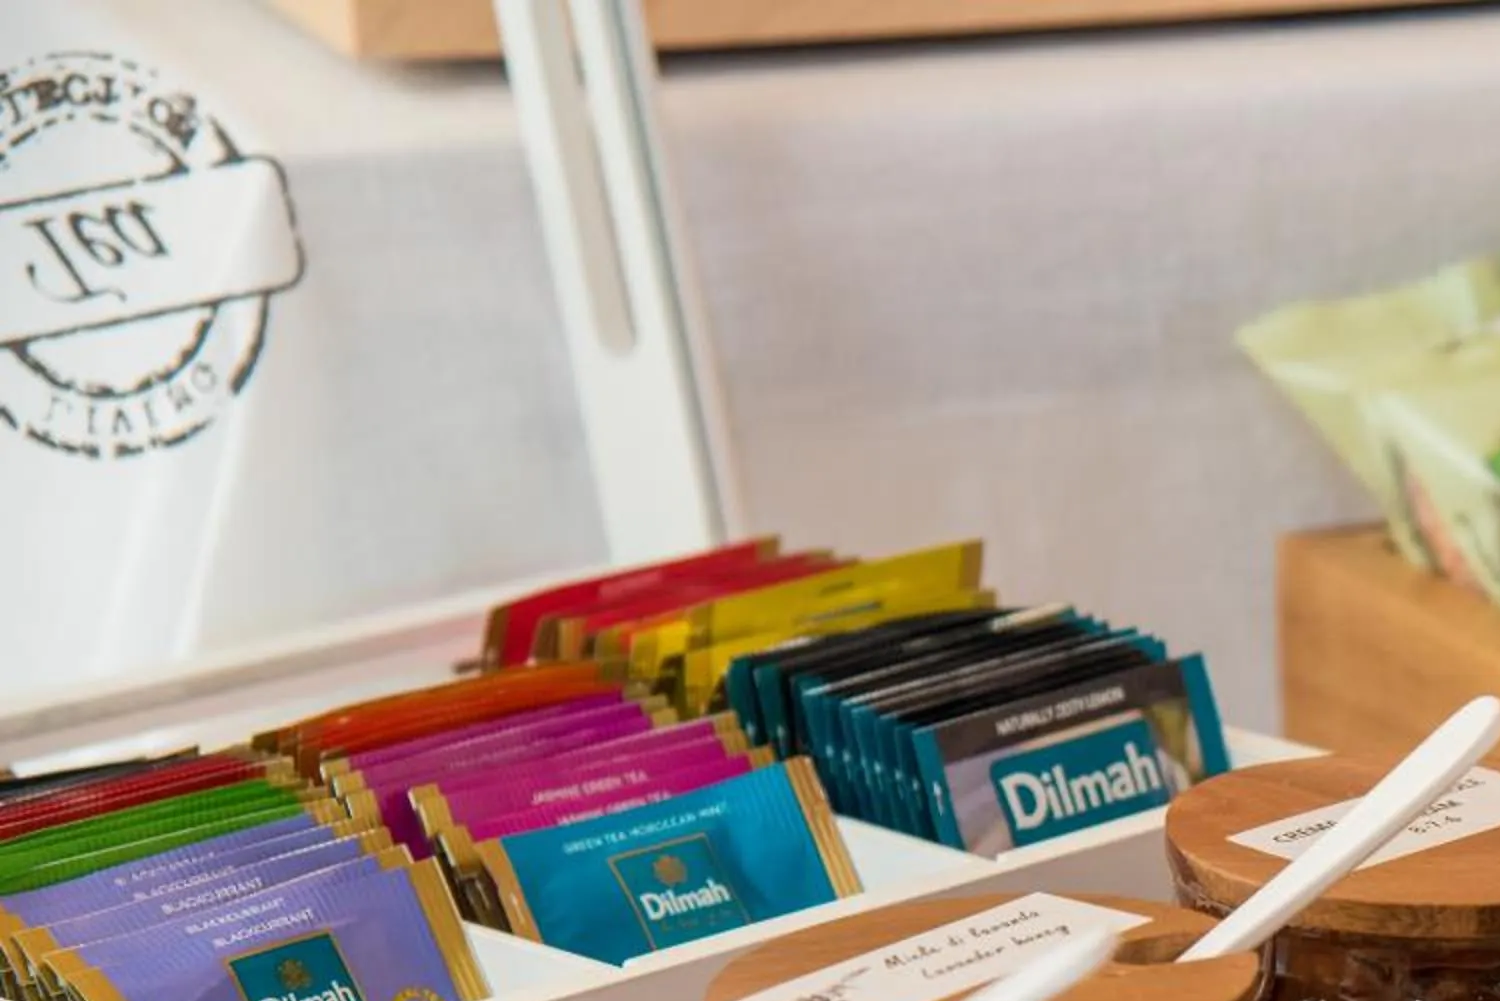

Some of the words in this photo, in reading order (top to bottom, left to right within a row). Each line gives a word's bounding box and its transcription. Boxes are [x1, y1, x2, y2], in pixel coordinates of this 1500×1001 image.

[623, 770, 648, 784] TEA
[1000, 741, 1161, 831] Dilmah
[604, 831, 627, 846] TEA
[640, 877, 731, 921] Dilmah
